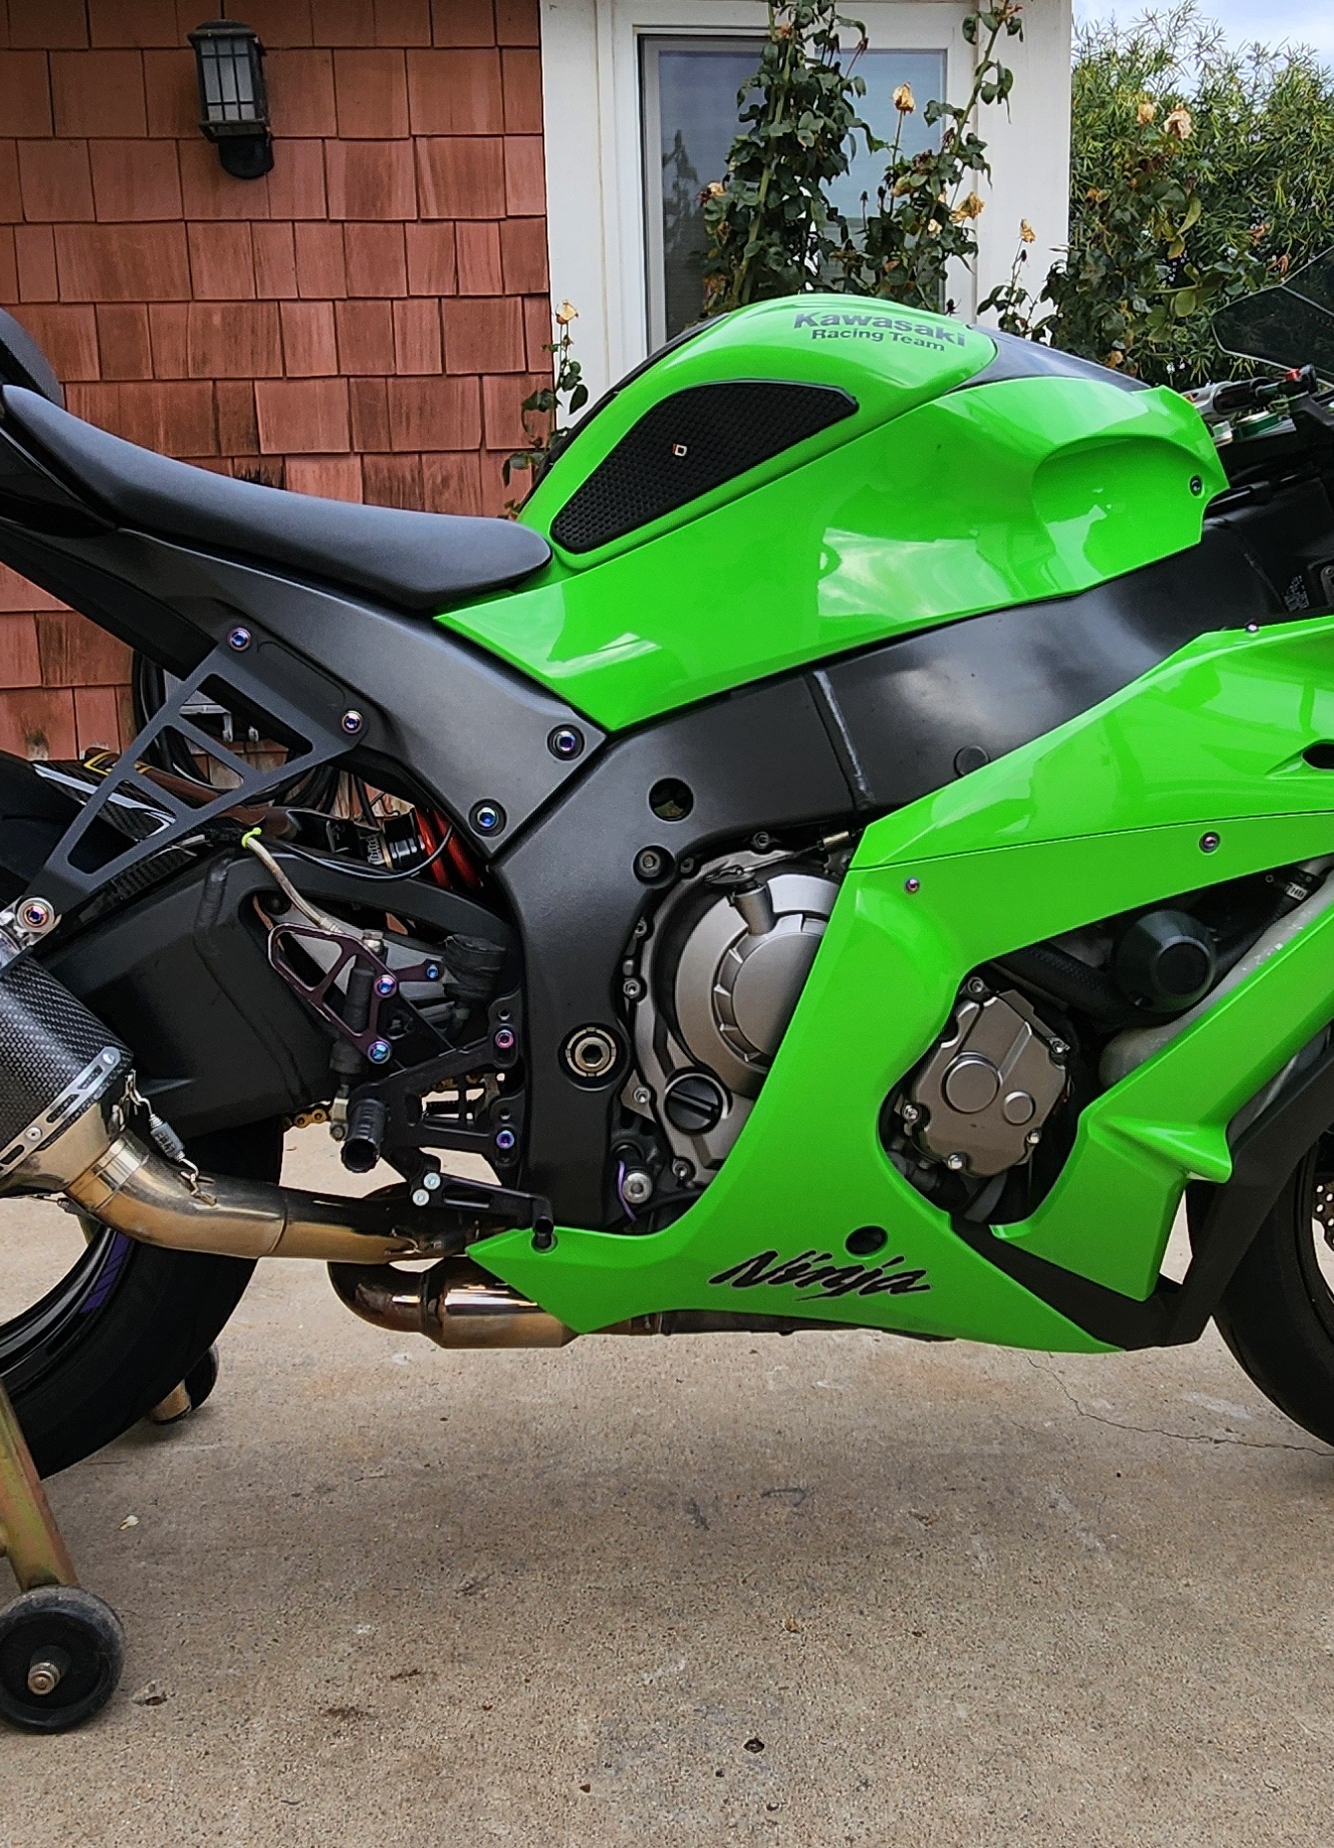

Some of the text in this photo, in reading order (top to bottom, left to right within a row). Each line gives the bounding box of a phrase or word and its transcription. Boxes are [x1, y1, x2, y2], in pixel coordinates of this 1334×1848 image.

[794, 311, 966, 347] Kawasaki
[811, 328, 945, 352] Racing Team
[708, 1250, 931, 1301] Ninja
